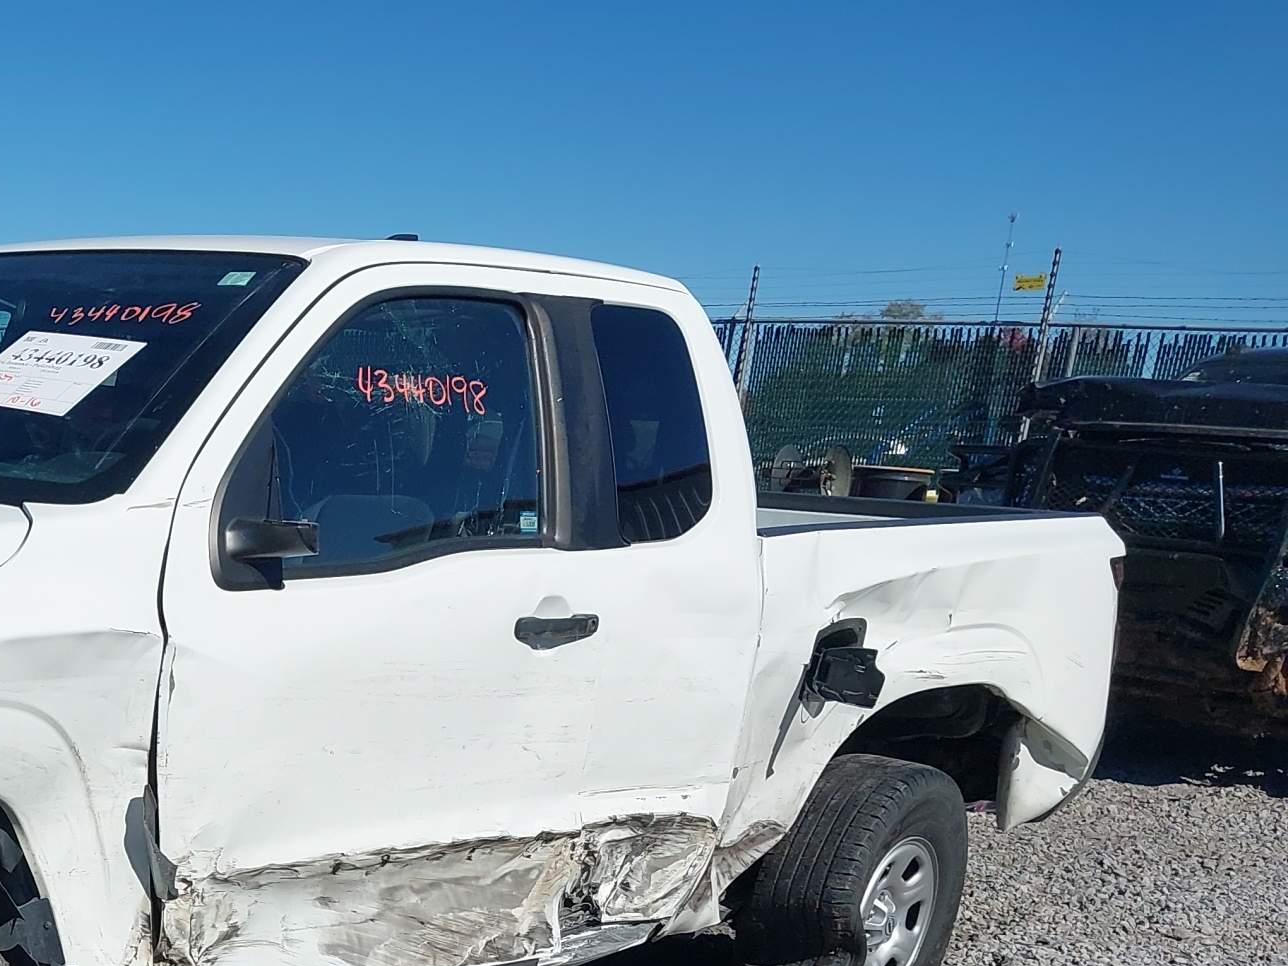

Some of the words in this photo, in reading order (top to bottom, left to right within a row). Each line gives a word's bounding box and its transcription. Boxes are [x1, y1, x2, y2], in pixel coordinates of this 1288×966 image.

[50, 302, 201, 325] 43440198
[11, 348, 110, 370] 43440198
[358, 365, 487, 415] 43440198
